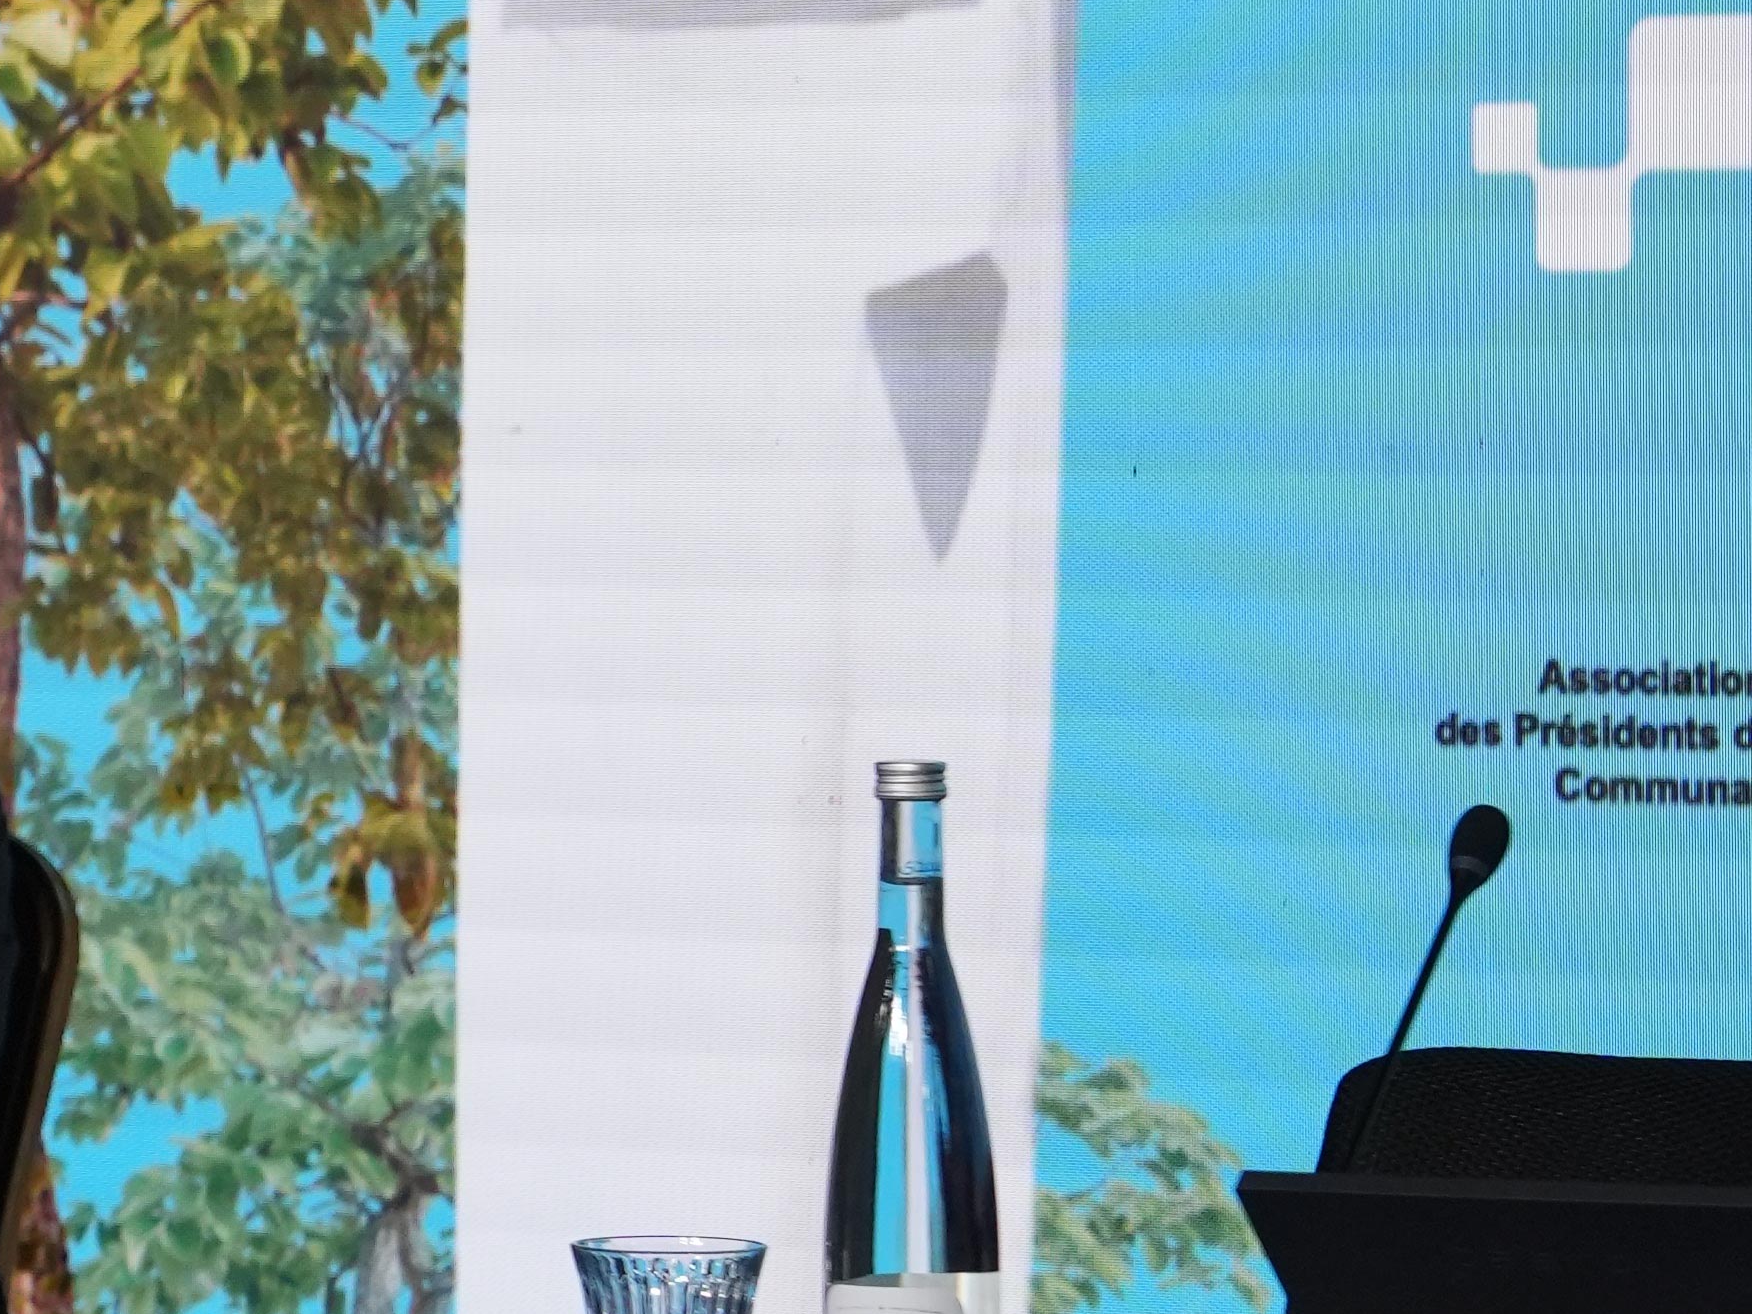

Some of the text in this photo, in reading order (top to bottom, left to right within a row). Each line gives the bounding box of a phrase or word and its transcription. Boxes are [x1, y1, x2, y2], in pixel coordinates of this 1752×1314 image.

[1537, 658, 1752, 696] Associatio
[1435, 712, 1502, 747] des
[1514, 713, 1720, 750] Présidents
